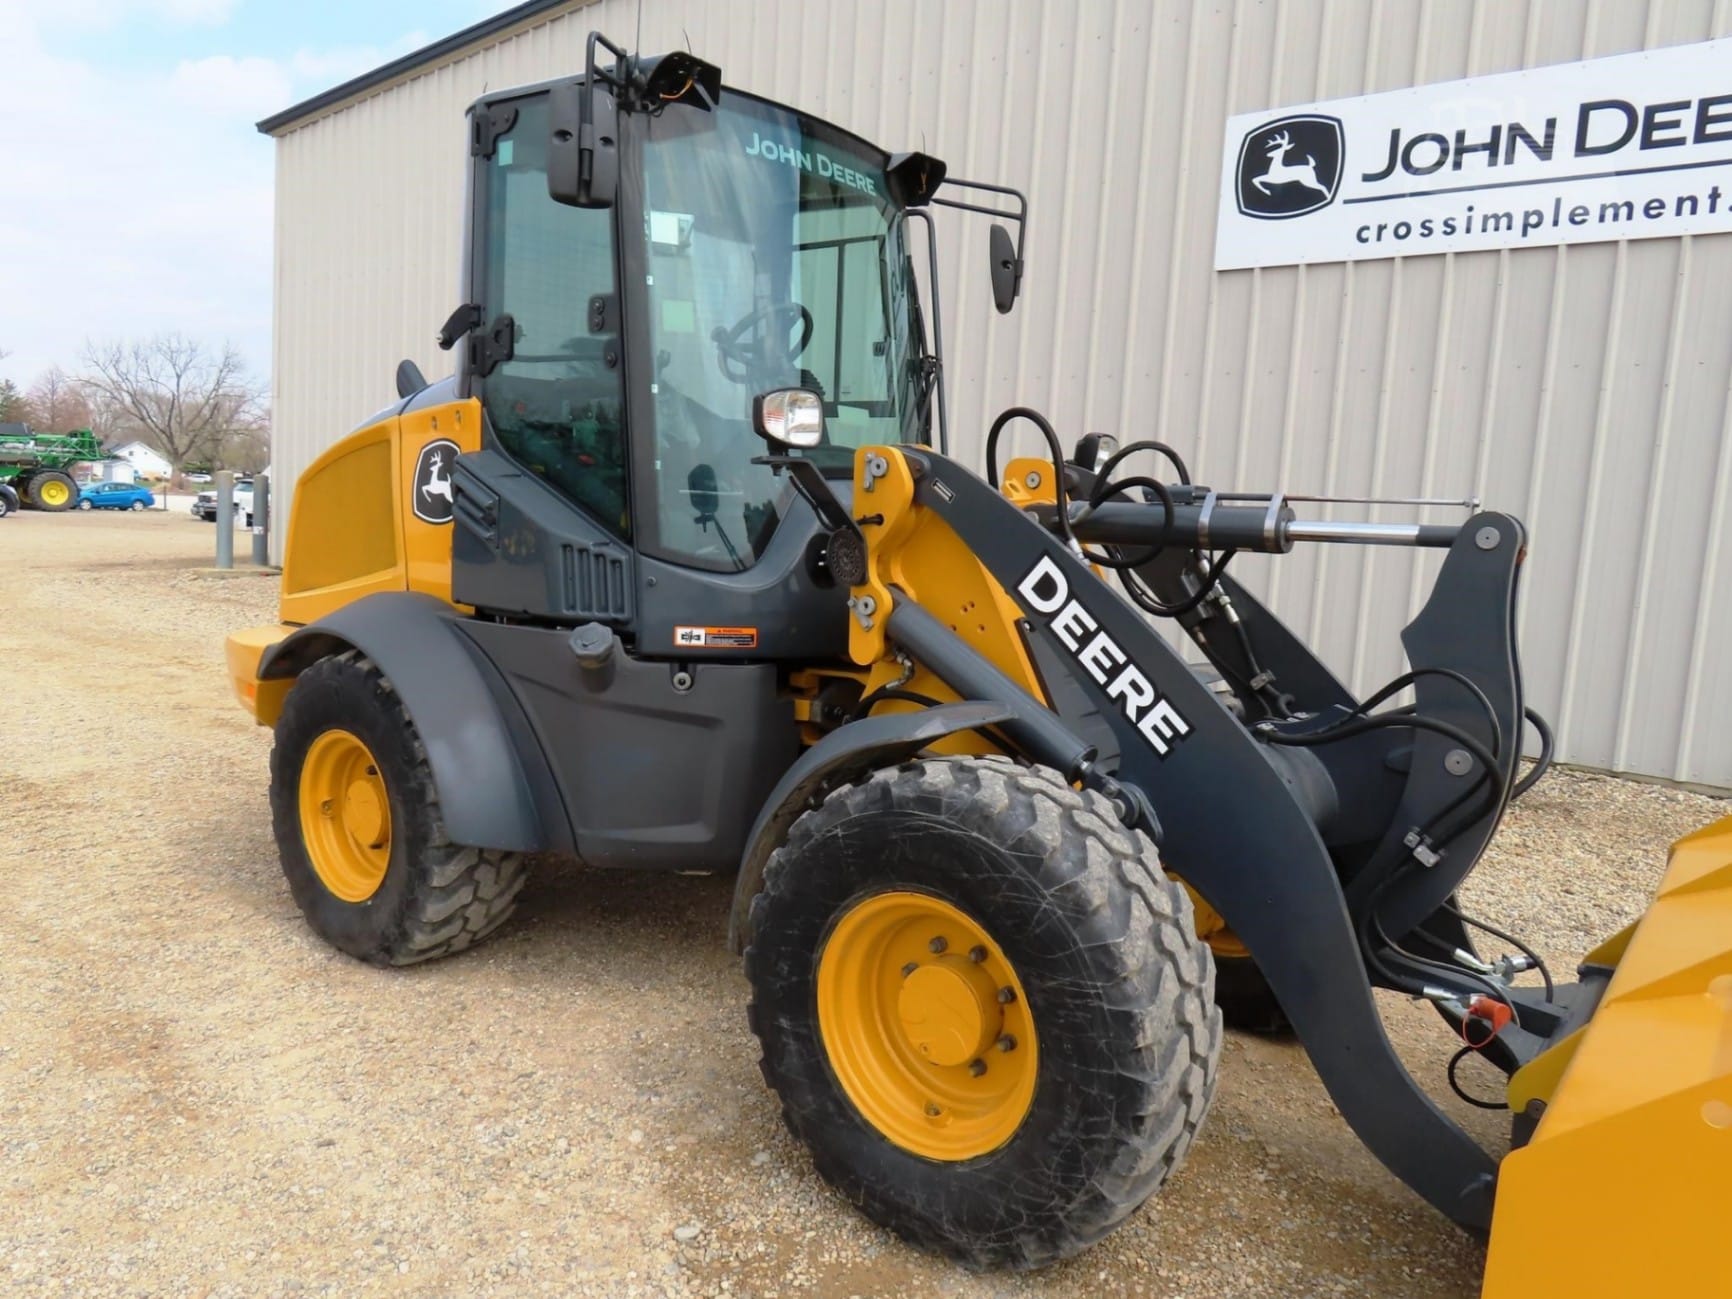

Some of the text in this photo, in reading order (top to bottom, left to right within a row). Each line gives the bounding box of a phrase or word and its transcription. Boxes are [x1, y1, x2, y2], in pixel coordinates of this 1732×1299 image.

[745, 132, 877, 197] JOHN DEERE
[1361, 117, 1557, 182] JOHN
[1017, 555, 1190, 756] DEERE
